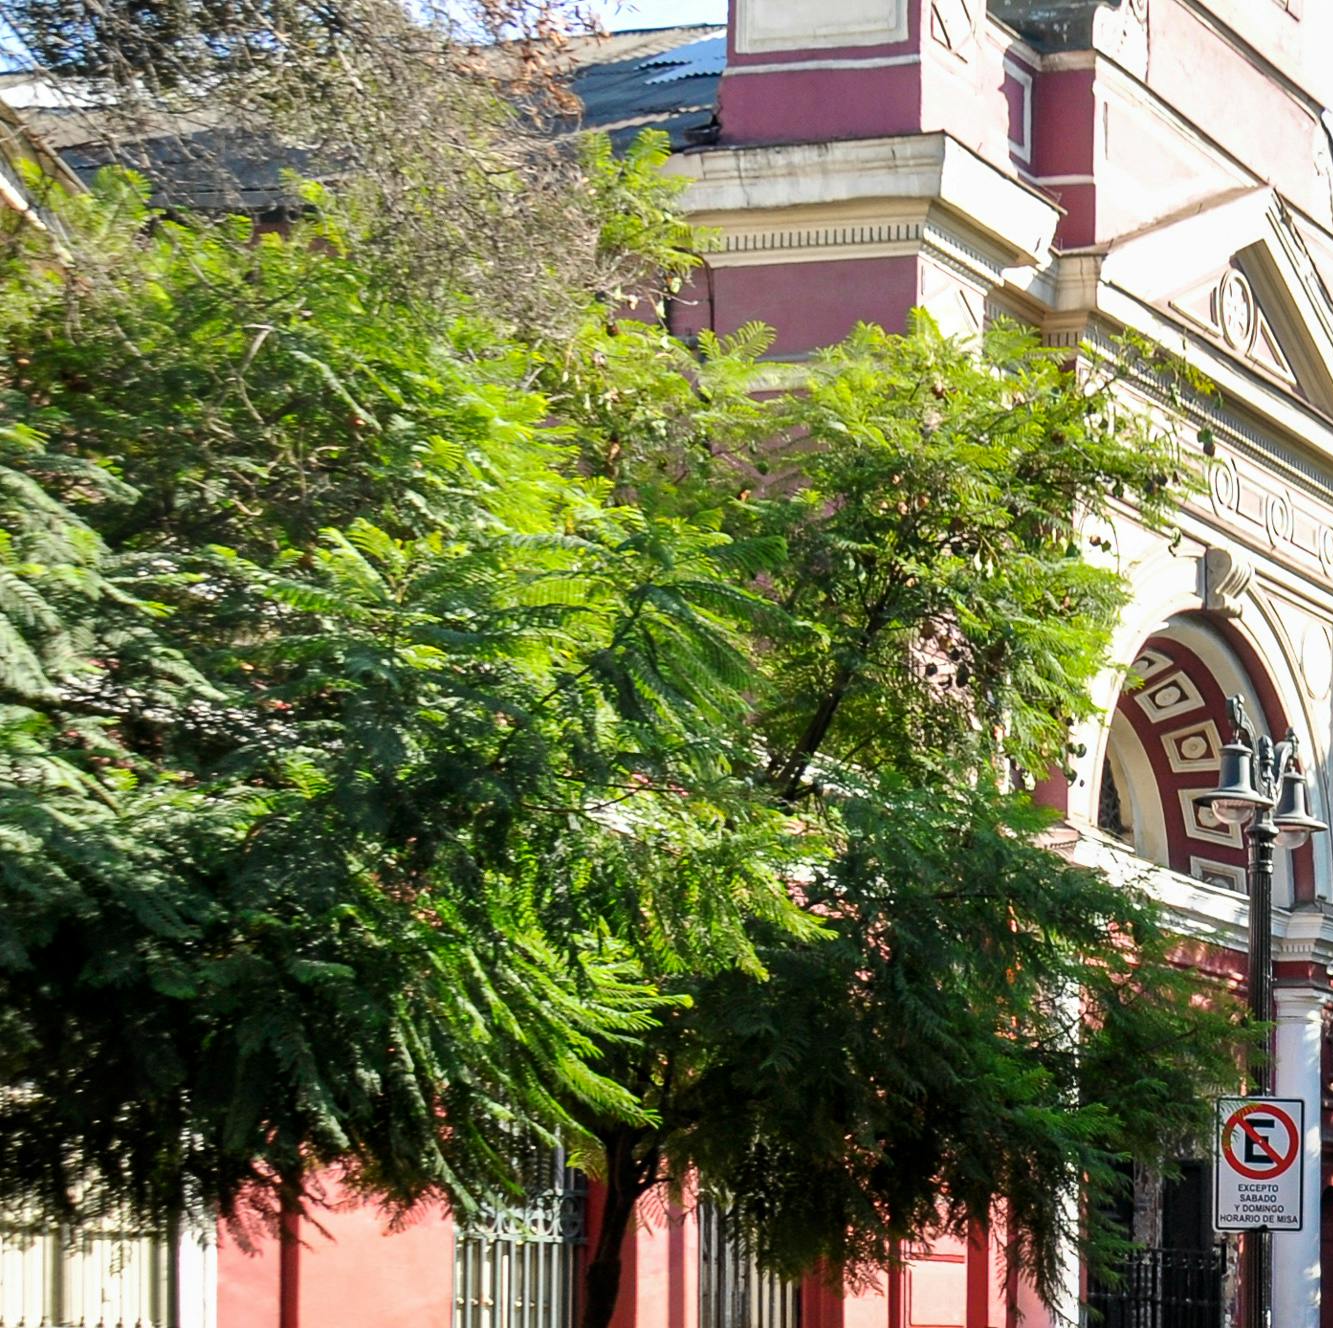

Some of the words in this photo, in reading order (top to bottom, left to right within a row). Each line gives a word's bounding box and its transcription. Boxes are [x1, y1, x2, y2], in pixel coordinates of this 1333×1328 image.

[1244, 1118, 1275, 1164] E
[1237, 1183, 1279, 1193] EXCEPTO
[1239, 1194, 1277, 1203] SABADO
[1234, 1204, 1240, 1213] Y
[1242, 1204, 1285, 1213] DOMINGO
[1220, 1214, 1261, 1223] HORARIO
[1262, 1215, 1275, 1223] DE
[1277, 1215, 1298, 1224] MISA
